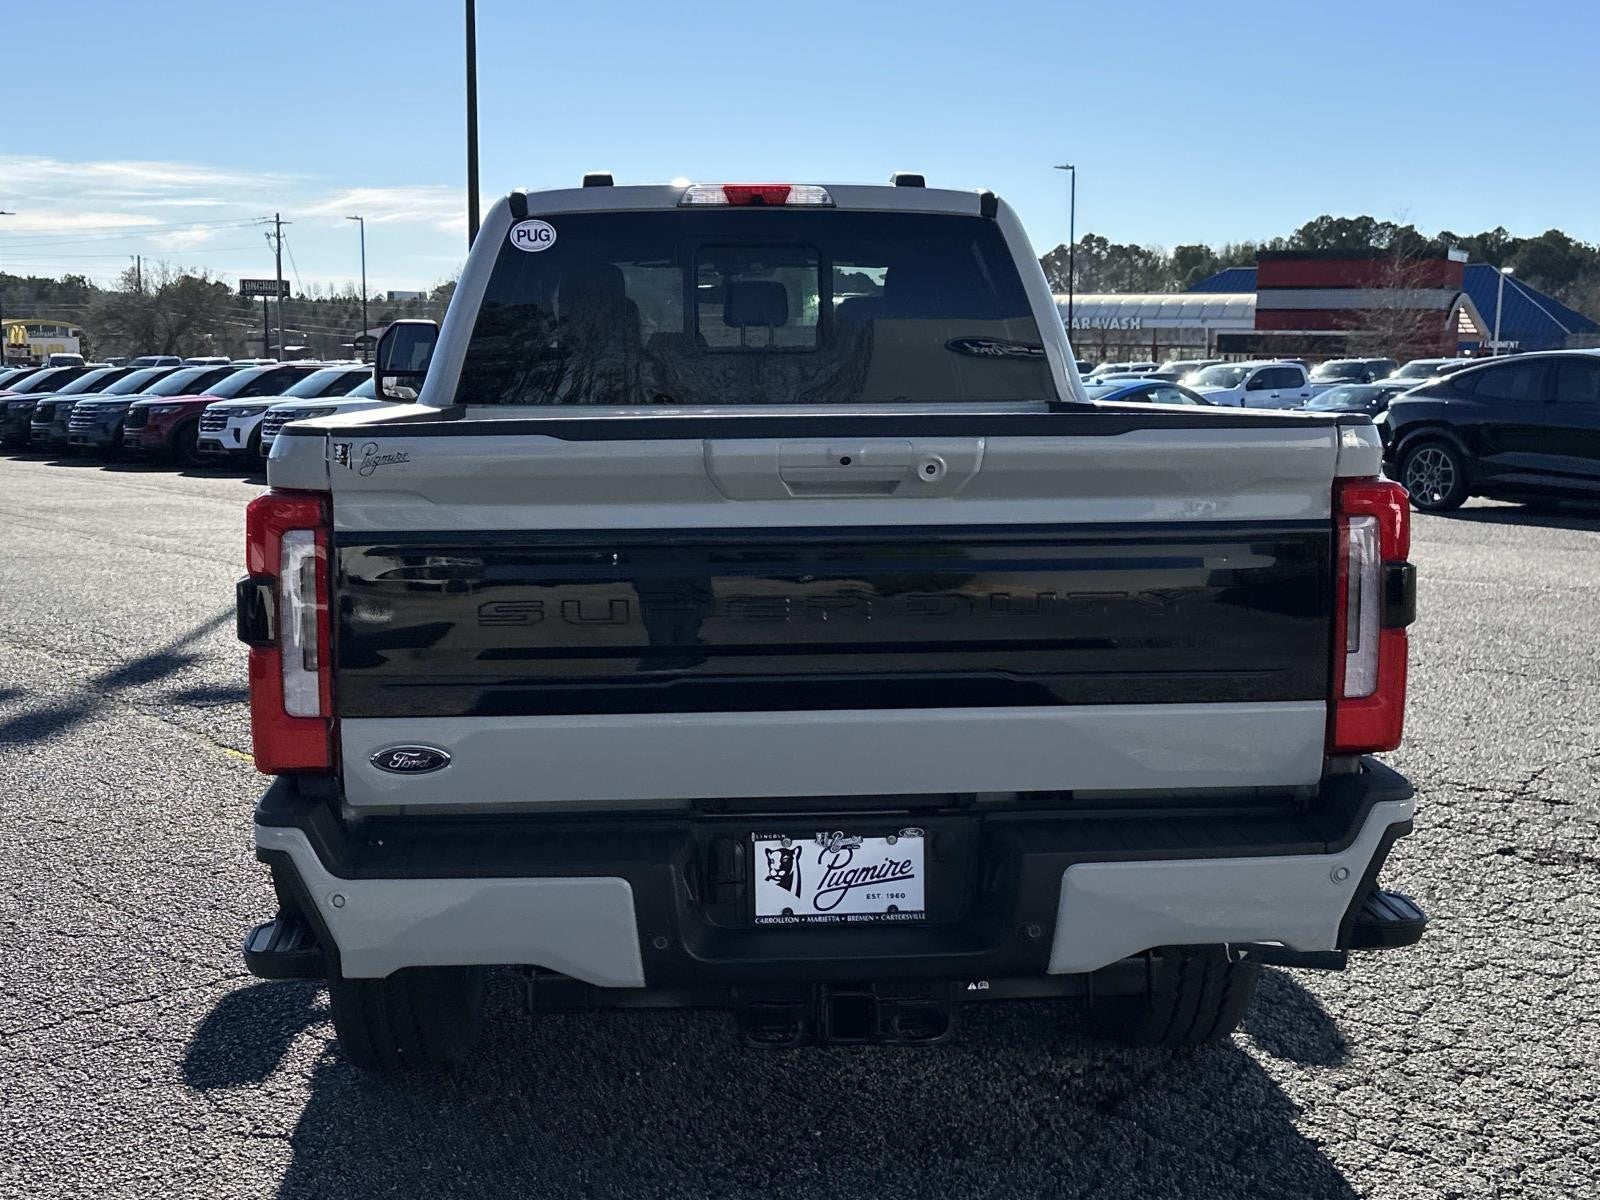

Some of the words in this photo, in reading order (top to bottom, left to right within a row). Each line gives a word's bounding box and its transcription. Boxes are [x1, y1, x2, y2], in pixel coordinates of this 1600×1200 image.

[516, 228, 551, 243] PUG
[1095, 317, 1142, 330] WASH
[358, 441, 411, 477] Pugmire
[478, 590, 873, 627] SUER
[812, 843, 915, 912] Pugmire
[754, 916, 800, 924] CARROLLTON
[880, 914, 926, 922] CARTERSVILLE
